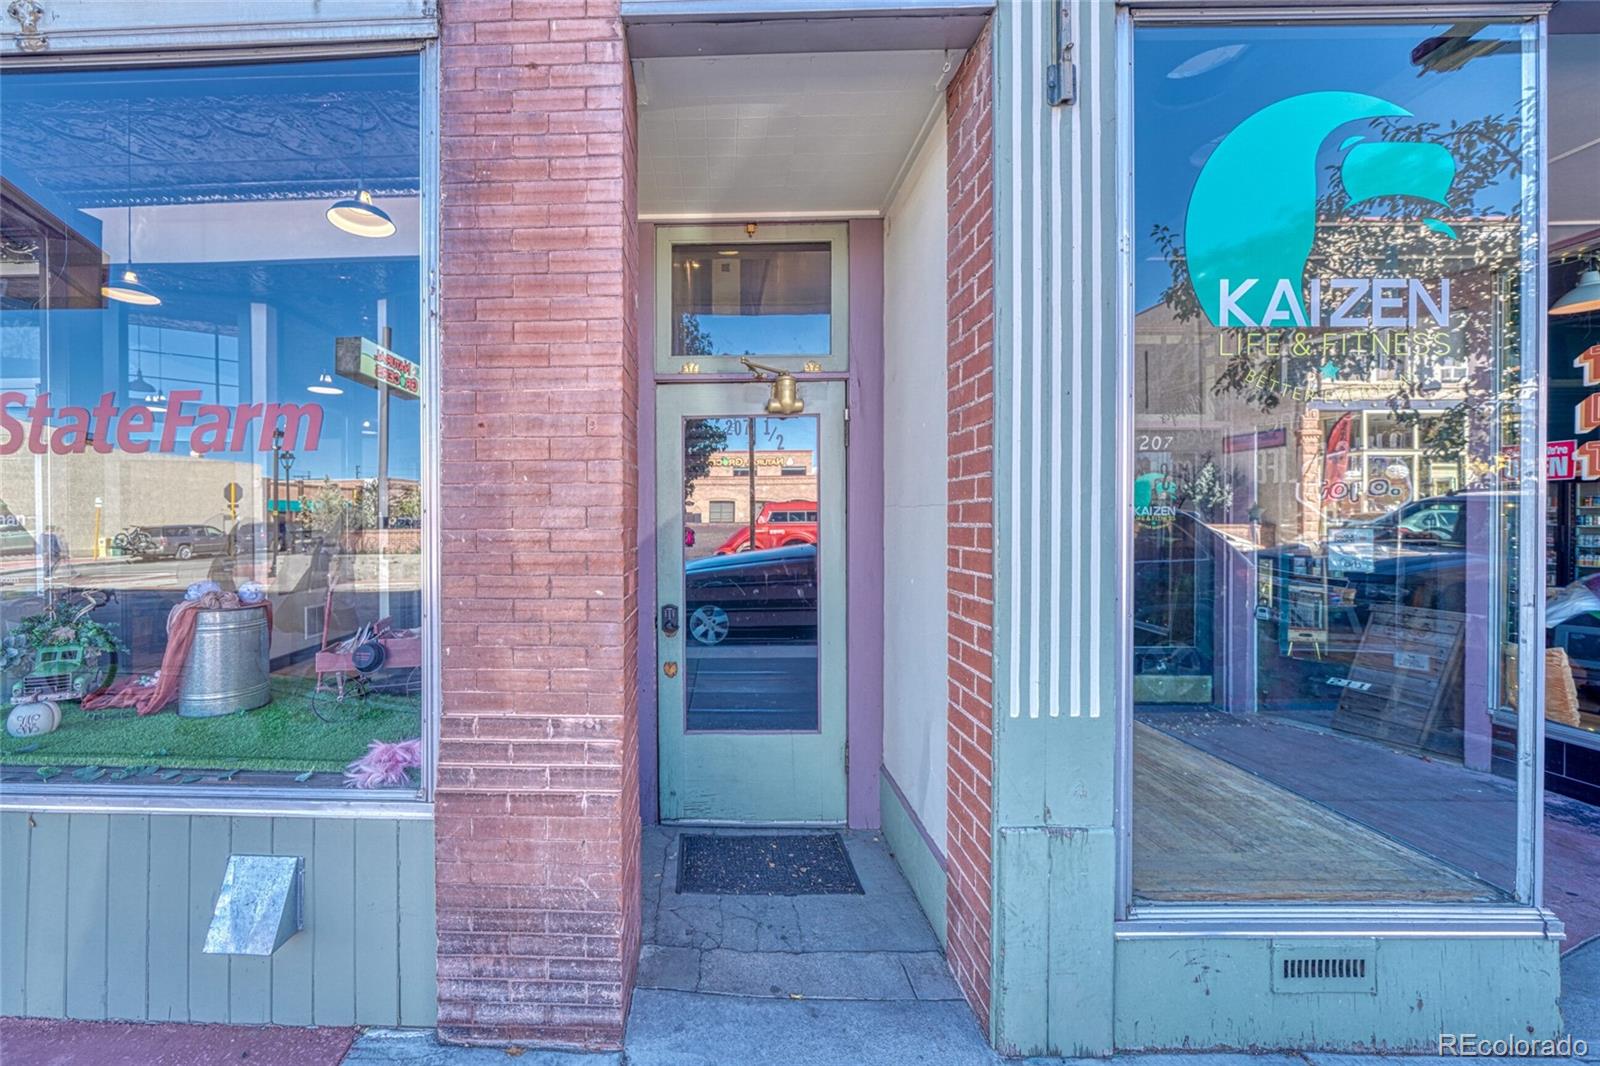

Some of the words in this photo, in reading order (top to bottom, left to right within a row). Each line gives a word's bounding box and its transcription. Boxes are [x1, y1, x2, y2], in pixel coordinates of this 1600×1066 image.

[1219, 278, 1450, 328] KAIZEN
[1219, 332, 1281, 356] LIFE
[1291, 332, 1312, 356] &
[1323, 332, 1452, 356] FITNESS
[1244, 368, 1321, 402] BETTER
[1138, 435, 1174, 450] 207
